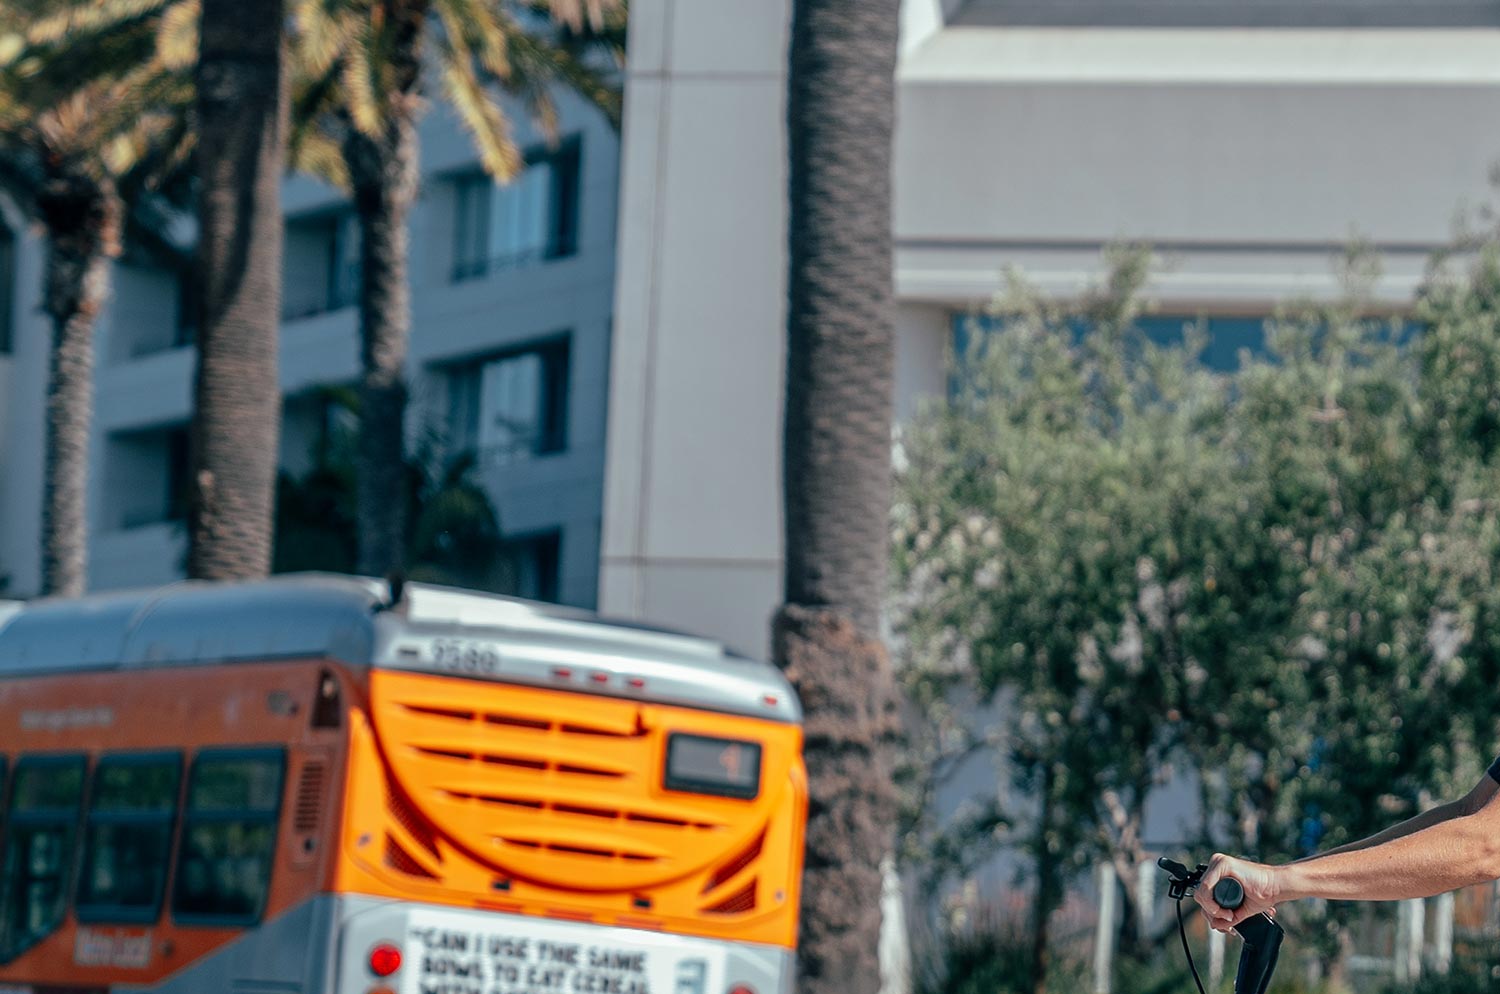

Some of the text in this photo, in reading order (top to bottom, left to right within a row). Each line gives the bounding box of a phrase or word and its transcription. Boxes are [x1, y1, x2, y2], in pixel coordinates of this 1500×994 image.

[489, 933, 529, 959] USE
[537, 940, 579, 965] THE
[588, 946, 646, 973] SAME
[422, 955, 484, 981] BOWL
[494, 963, 519, 983] TO
[527, 966, 565, 989] EAT
